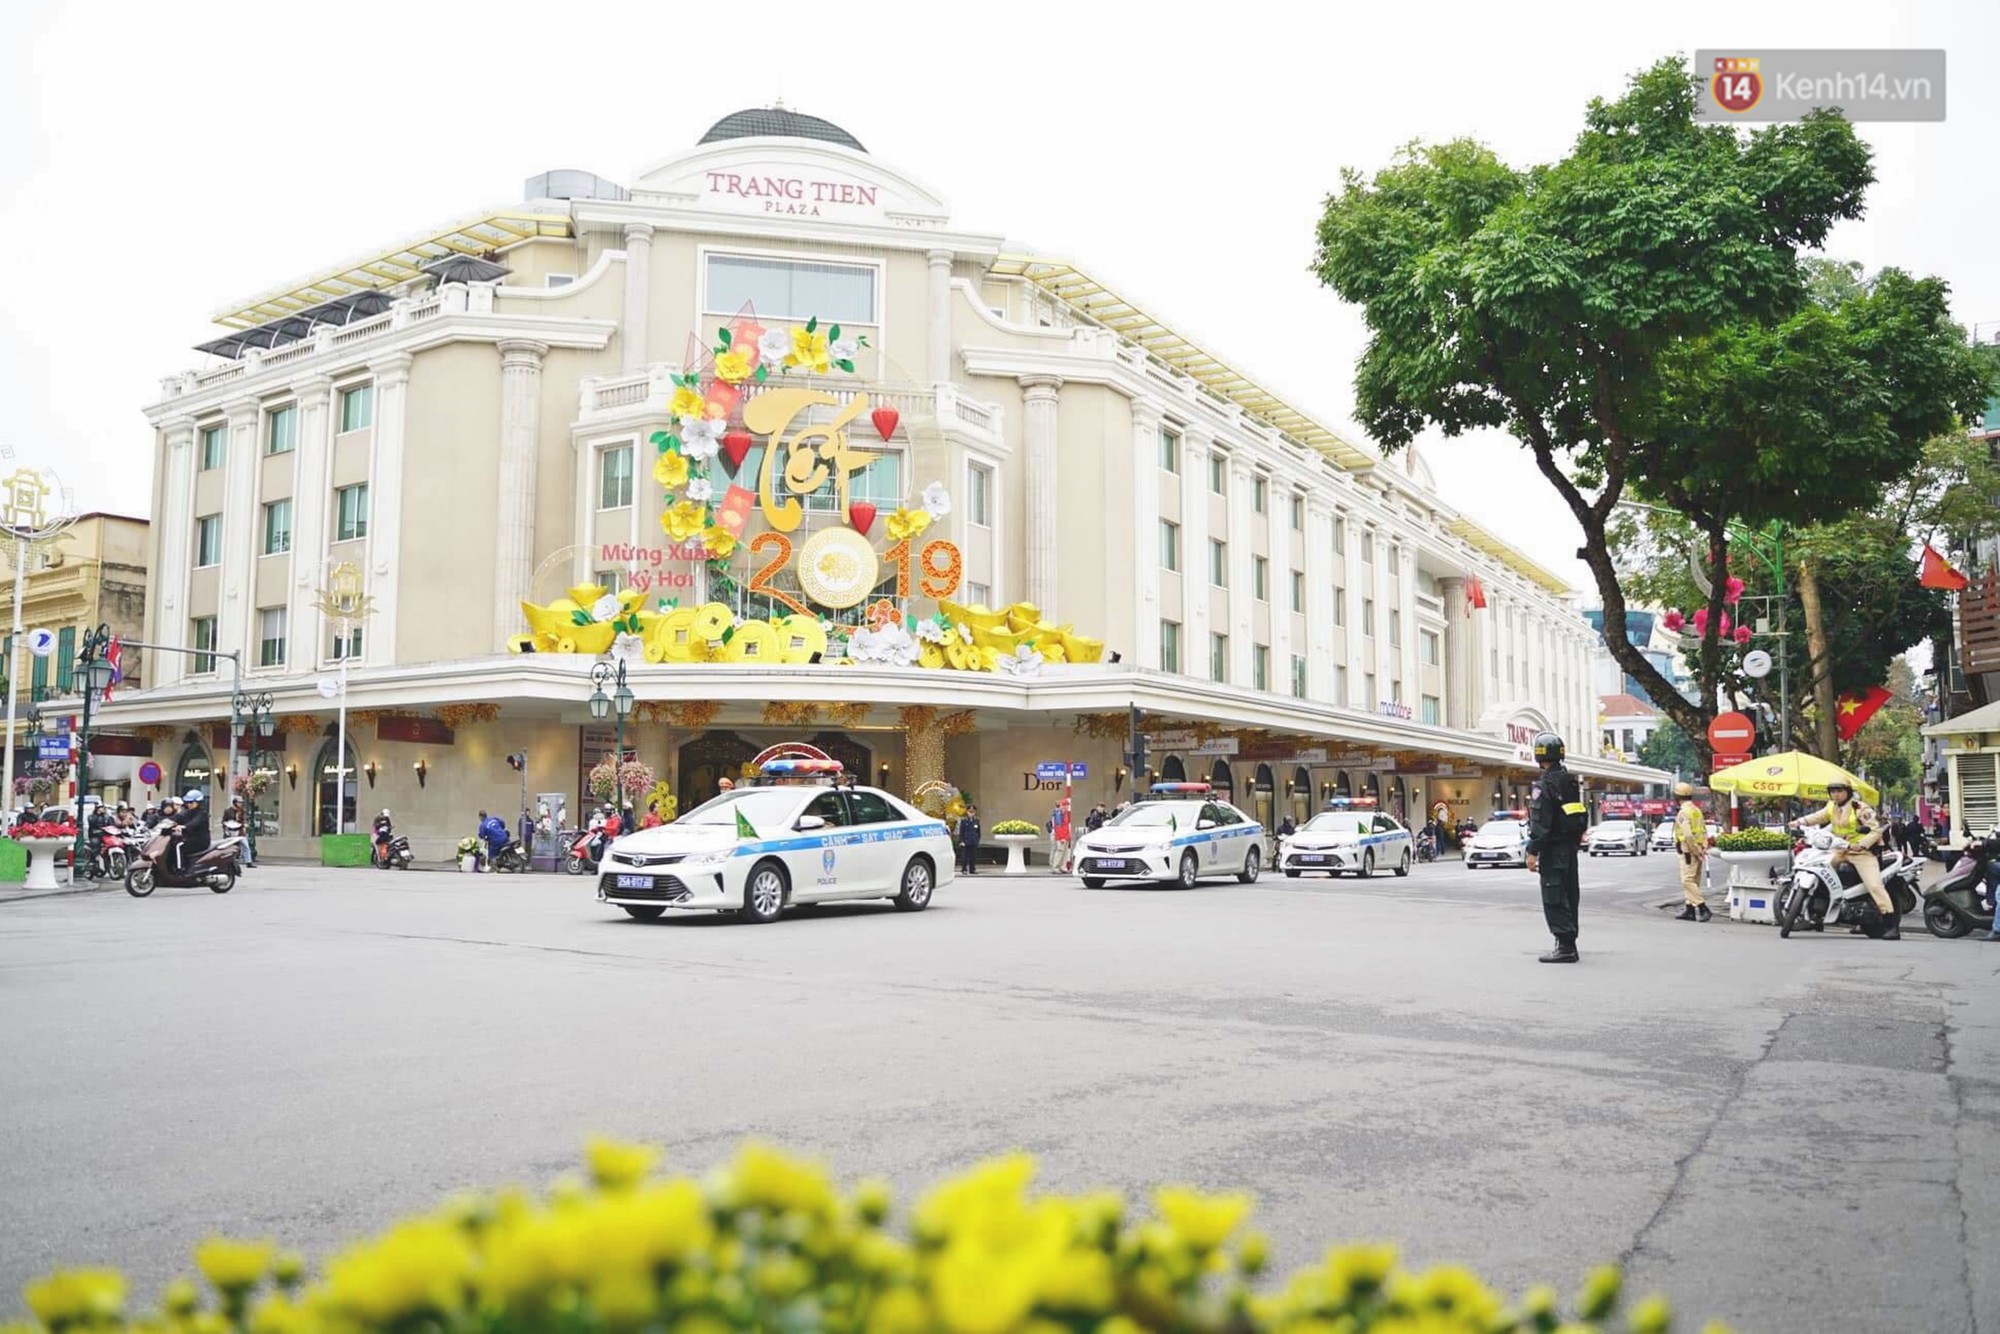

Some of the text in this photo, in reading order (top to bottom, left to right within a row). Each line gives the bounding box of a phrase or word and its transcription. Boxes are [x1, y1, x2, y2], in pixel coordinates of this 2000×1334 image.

[707, 172, 878, 206] TRANG TIEN
[764, 200, 821, 217] PLAZA
[602, 542, 662, 567] Mừng
[628, 569, 652, 592] Kỷ
[1506, 722, 1529, 746] TRANG
[1023, 772, 1063, 791] Dior
[1752, 781, 1784, 791] CSGT
[817, 878, 838, 886] POLICE
